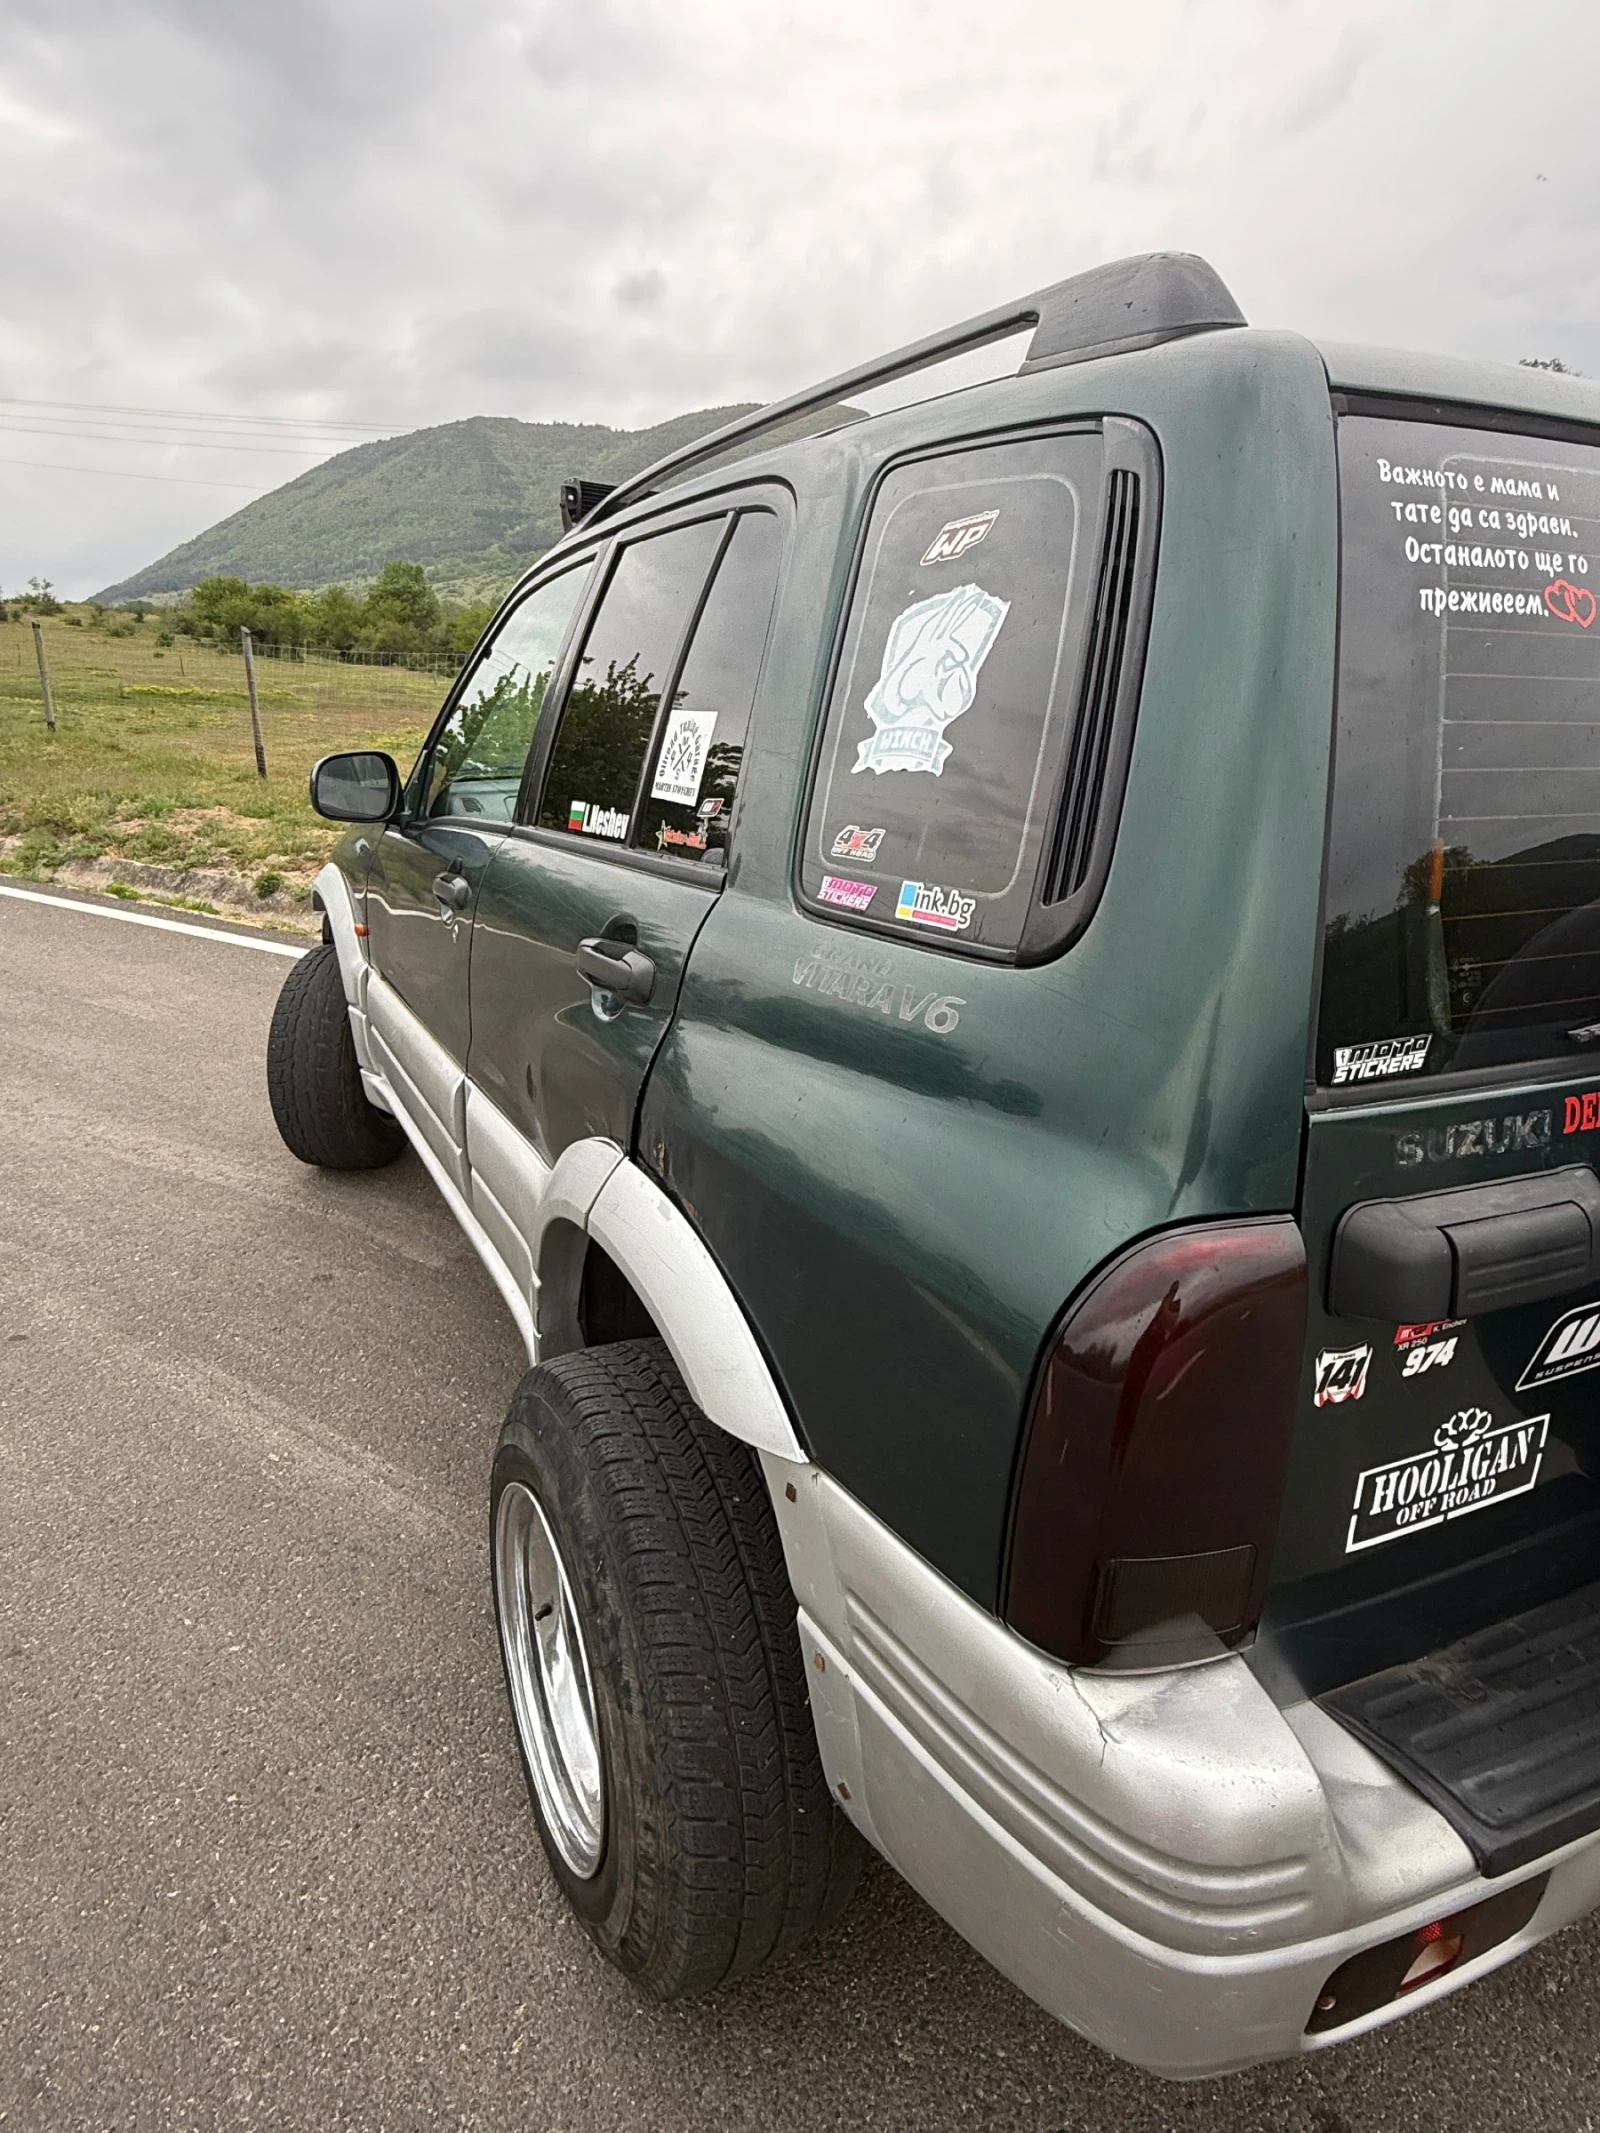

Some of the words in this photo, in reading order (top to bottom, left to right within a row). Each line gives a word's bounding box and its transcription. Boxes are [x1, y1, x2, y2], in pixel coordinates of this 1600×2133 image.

[1377, 459, 1467, 490] Важното
[1474, 475, 1485, 491] е
[1491, 476, 1542, 499] мама
[1548, 483, 1560, 501] и
[1391, 501, 1441, 523] тате
[1449, 507, 1472, 533] да
[1479, 508, 1501, 529] са
[1507, 512, 1578, 538] здрави.
[925, 522, 991, 560] WP
[1405, 536, 1529, 570] Останалото
[1535, 551, 1563, 577] ще
[1568, 554, 1588, 574] го
[1420, 587, 1549, 617] преживеем.
[880, 729, 932, 752] WINCH
[817, 889, 871, 911] STICKERS
[914, 885, 973, 925] ink.bg
[811, 942, 896, 978] GRAND
[792, 957, 897, 1015] VITARA
[899, 984, 967, 1035] V6
[1333, 1053, 1427, 1083] STICKERS
[1396, 1109, 1553, 1168] SUZUKI
[1315, 1356, 1367, 1395] 141
[1402, 1337, 1459, 1377] 974
[1369, 1426, 1535, 1516] HOOLIGAN
[1396, 1497, 1437, 1526] OFF
[1440, 1478, 1497, 1511] ROAD
